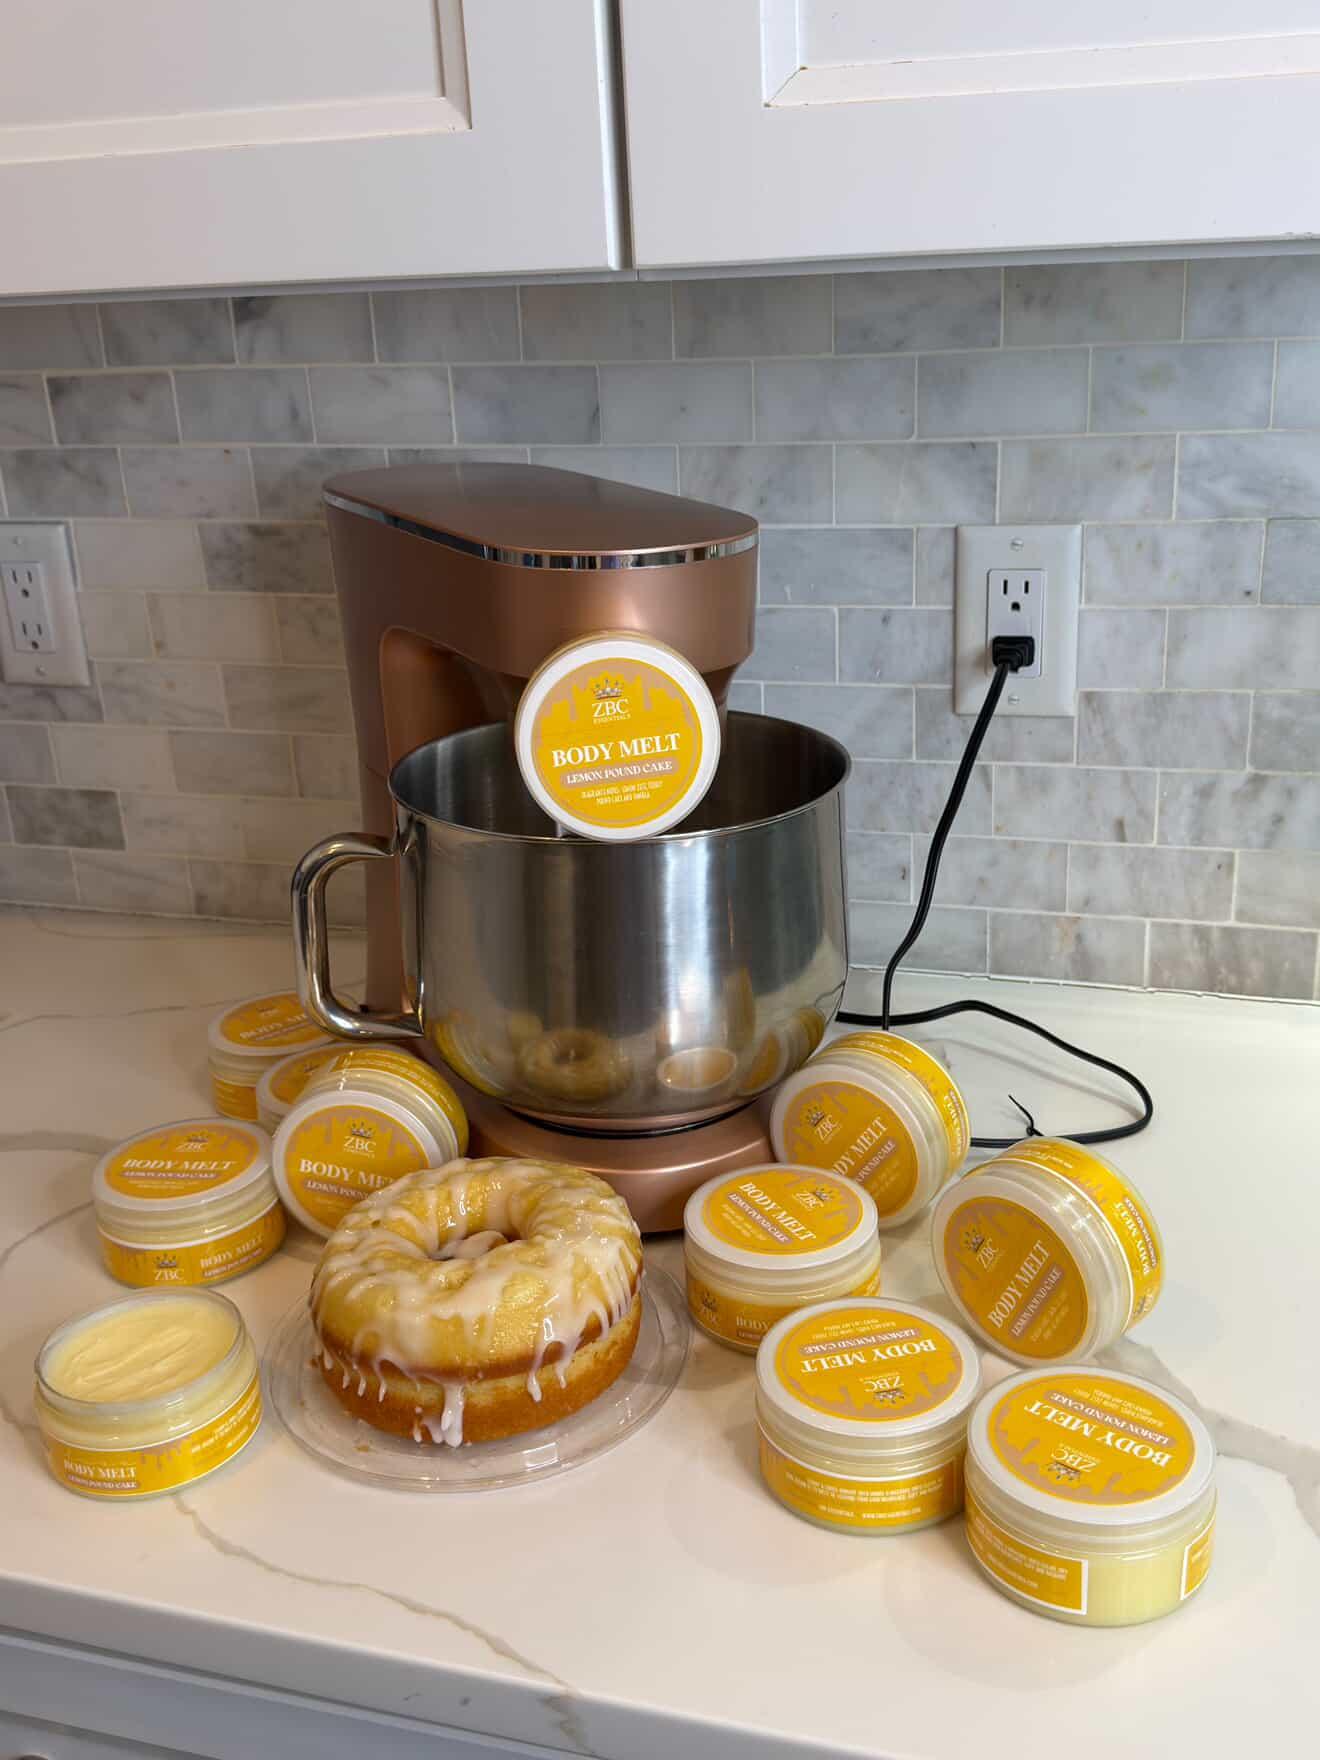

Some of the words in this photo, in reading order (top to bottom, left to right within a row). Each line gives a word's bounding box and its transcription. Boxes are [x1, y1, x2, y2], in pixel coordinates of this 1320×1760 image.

[592, 698, 629, 719] ZBC
[552, 741, 614, 768] BODY
[619, 733, 681, 758] MELT
[566, 769, 604, 785] LEMON
[604, 765, 641, 780] POUND
[642, 760, 673, 774] CAKE
[815, 1114, 838, 1141] ZBC
[849, 1116, 887, 1158] MELT
[343, 1135, 376, 1153] ZBC
[122, 1159, 178, 1170] BODY
[181, 1160, 237, 1171] MELT
[300, 1158, 354, 1183] BODY
[739, 1182, 782, 1212] BODY
[772, 1211, 817, 1241] MELT
[987, 1280, 1023, 1328] BODY
[1015, 1239, 1050, 1289] MELT
[871, 1339, 937, 1361] BODY
[801, 1352, 867, 1374] MELT
[862, 1375, 905, 1393] ZBC
[1049, 1392, 1084, 1412] CAKE
[1023, 1400, 1097, 1438] MELT
[1084, 1406, 1128, 1430] POUND
[1126, 1423, 1169, 1445] LEMON
[1050, 1446, 1097, 1473] ZBC
[1096, 1431, 1173, 1468] BODY
[97, 1465, 137, 1480] MELT
